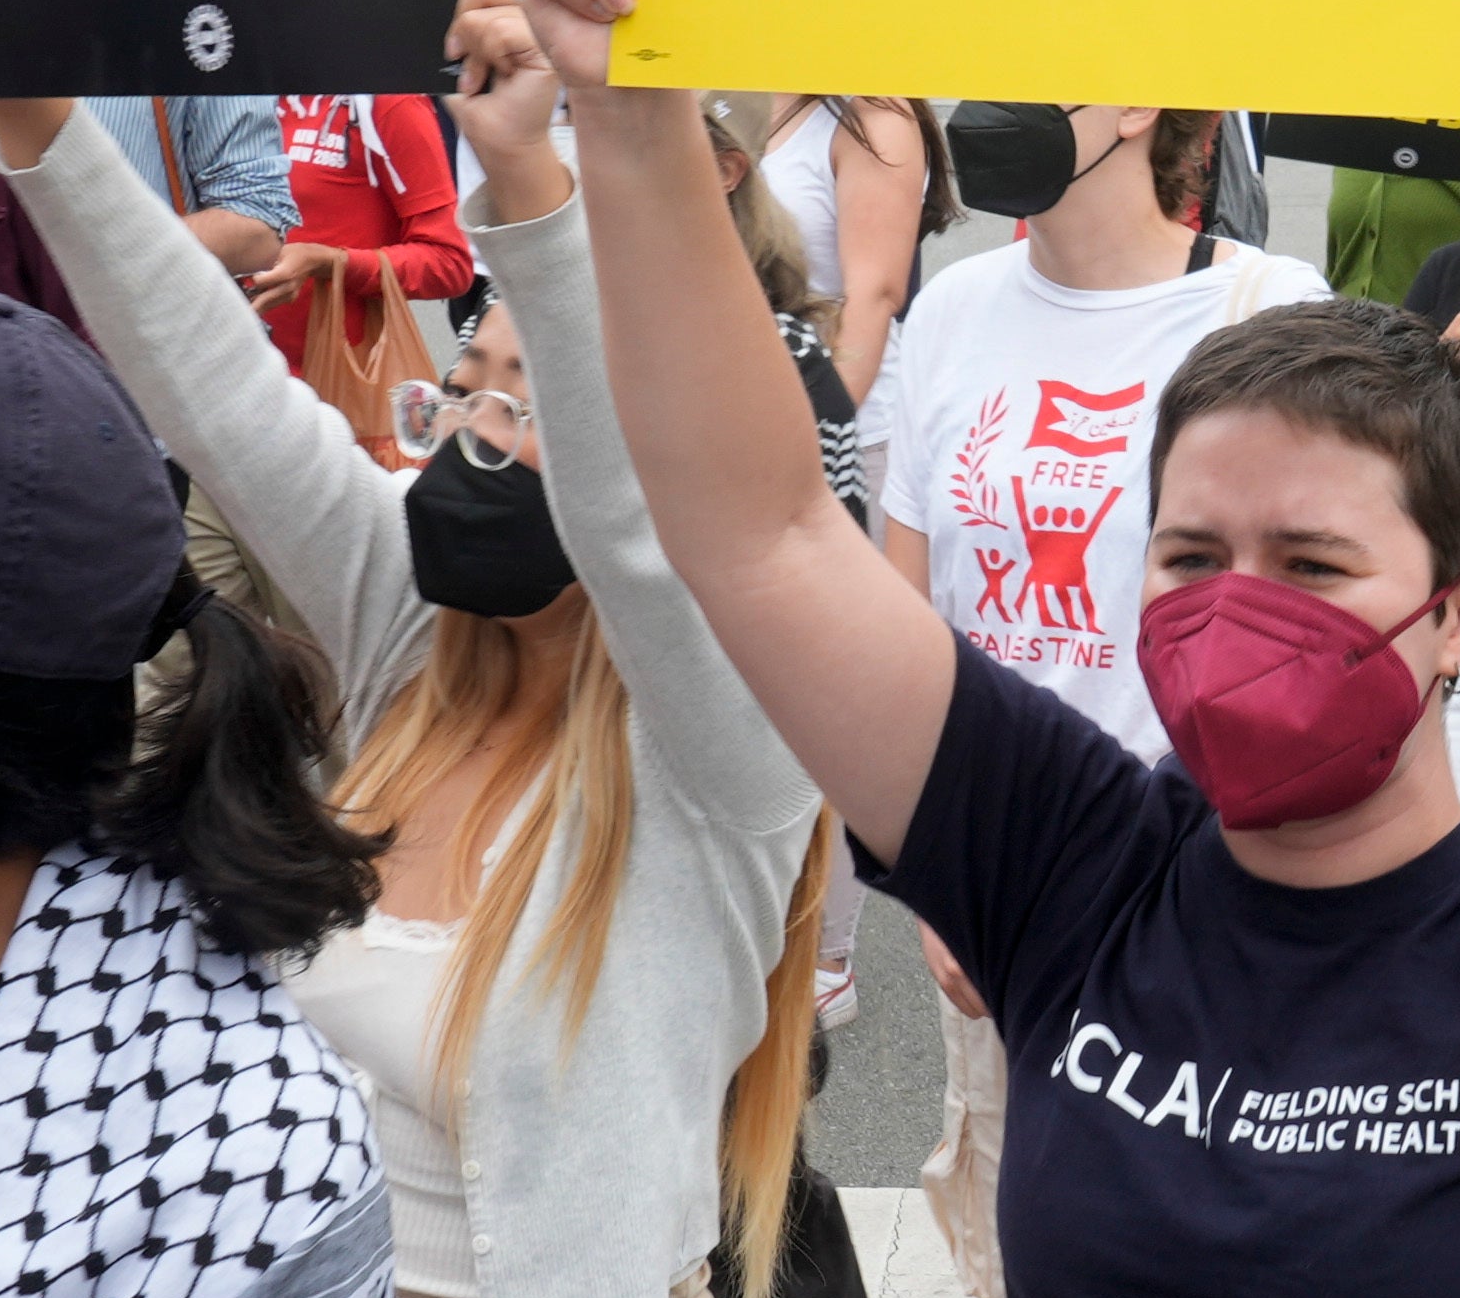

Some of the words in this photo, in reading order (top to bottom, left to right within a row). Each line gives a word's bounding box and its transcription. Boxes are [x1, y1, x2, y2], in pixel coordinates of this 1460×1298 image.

[1031, 461, 1109, 489] FREE
[1239, 1084, 1389, 1121] FIELDING
[1229, 1118, 1349, 1153] PUBLIC
